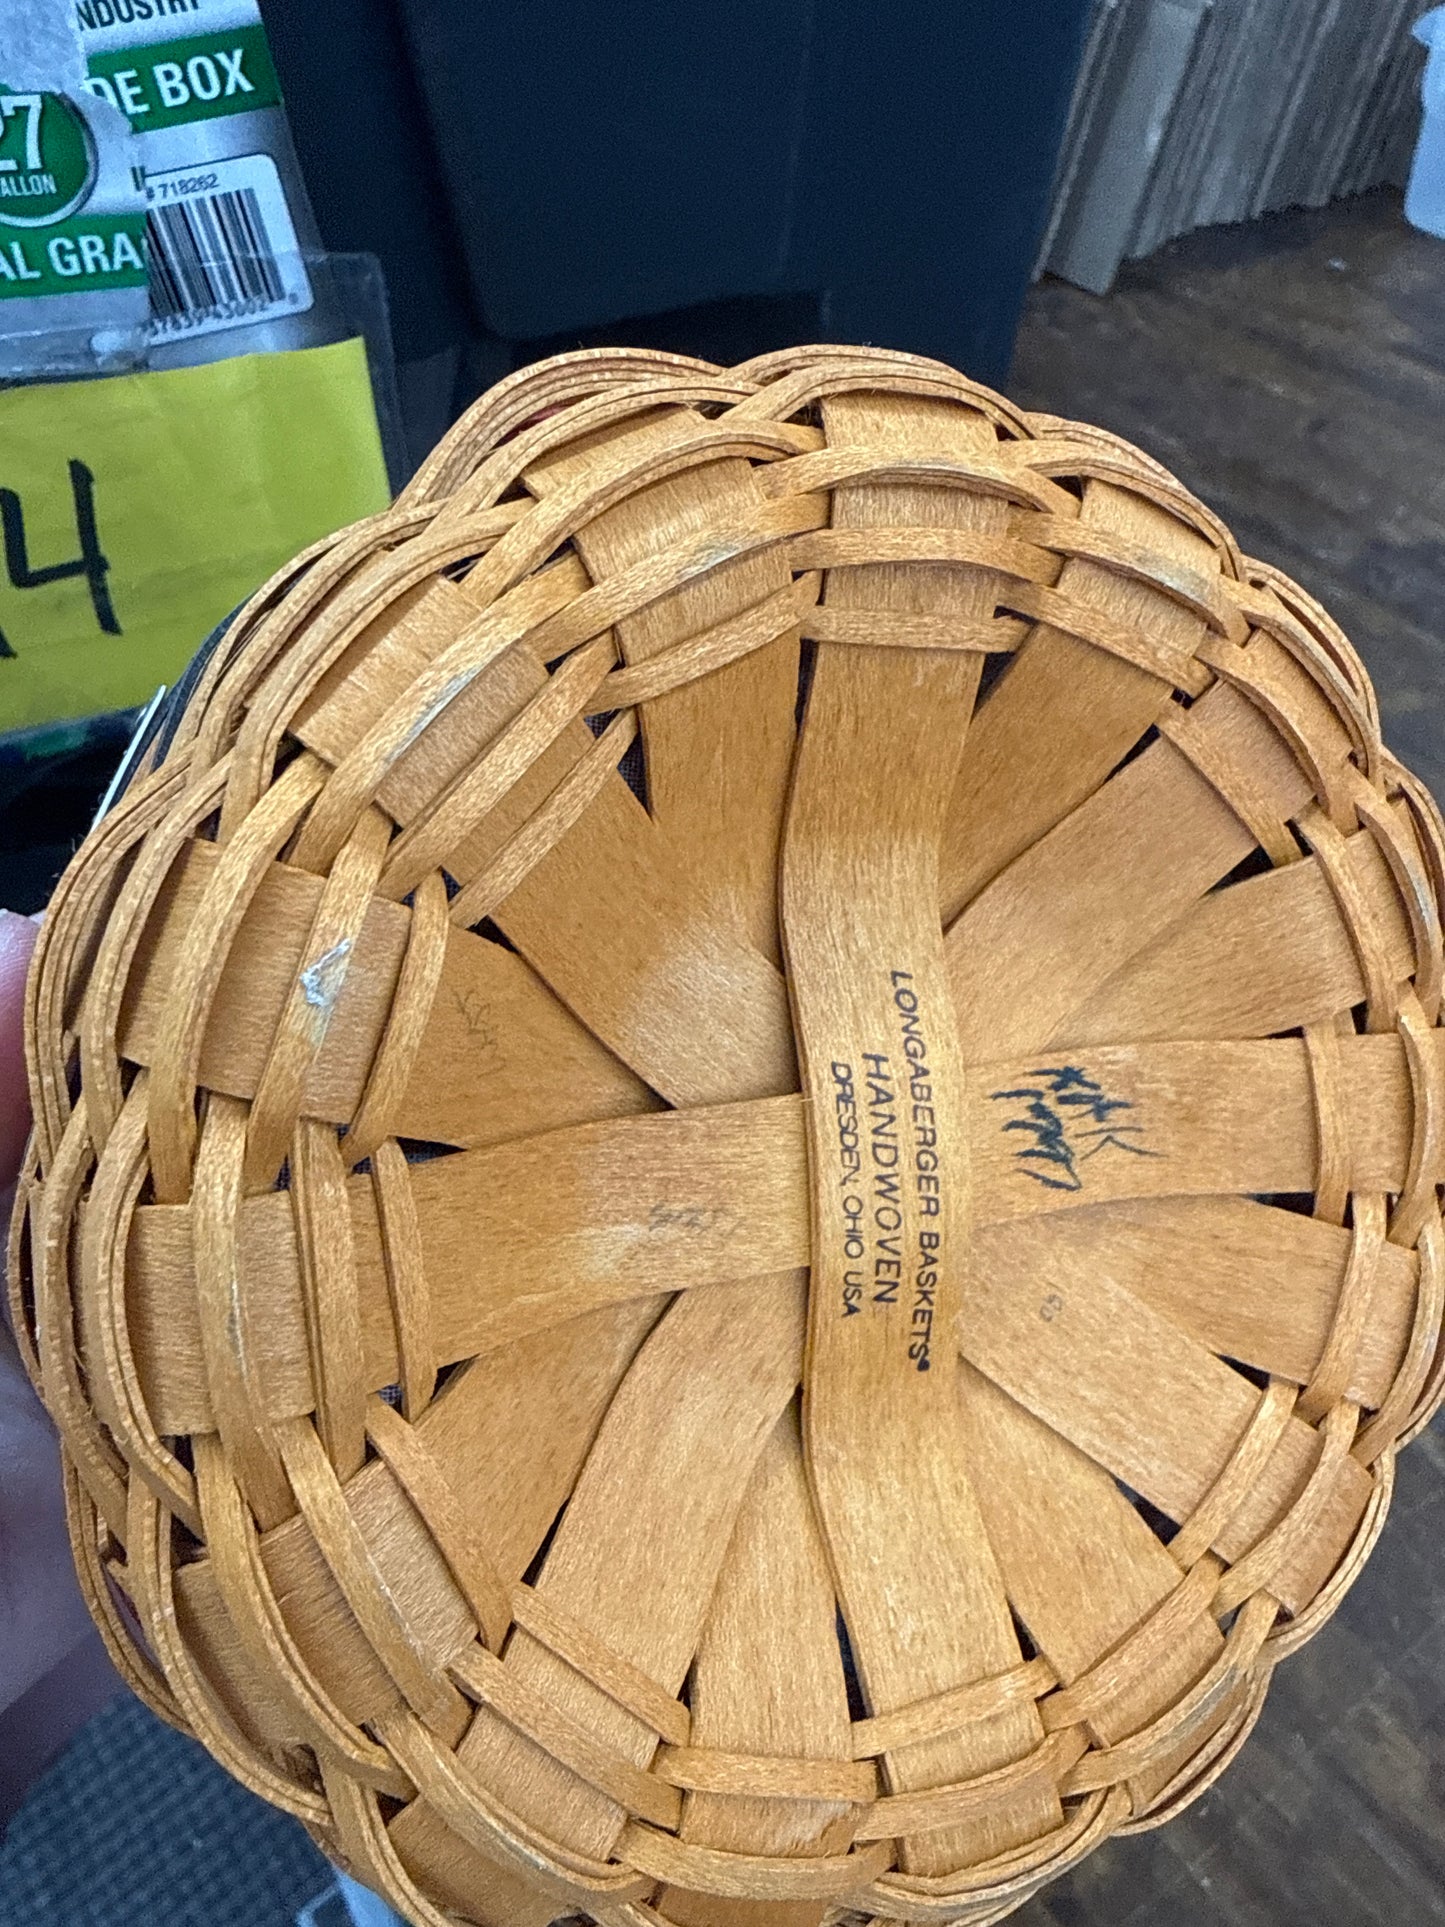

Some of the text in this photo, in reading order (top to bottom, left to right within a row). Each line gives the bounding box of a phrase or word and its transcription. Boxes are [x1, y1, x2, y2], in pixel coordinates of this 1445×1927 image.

[153, 49, 255, 107] BOX
[890, 970, 940, 1216] LONGABERGER
[862, 1053, 902, 1304] HANDWOVEN
[843, 1195, 865, 1260] OHIO
[842, 1272, 863, 1318] USA
